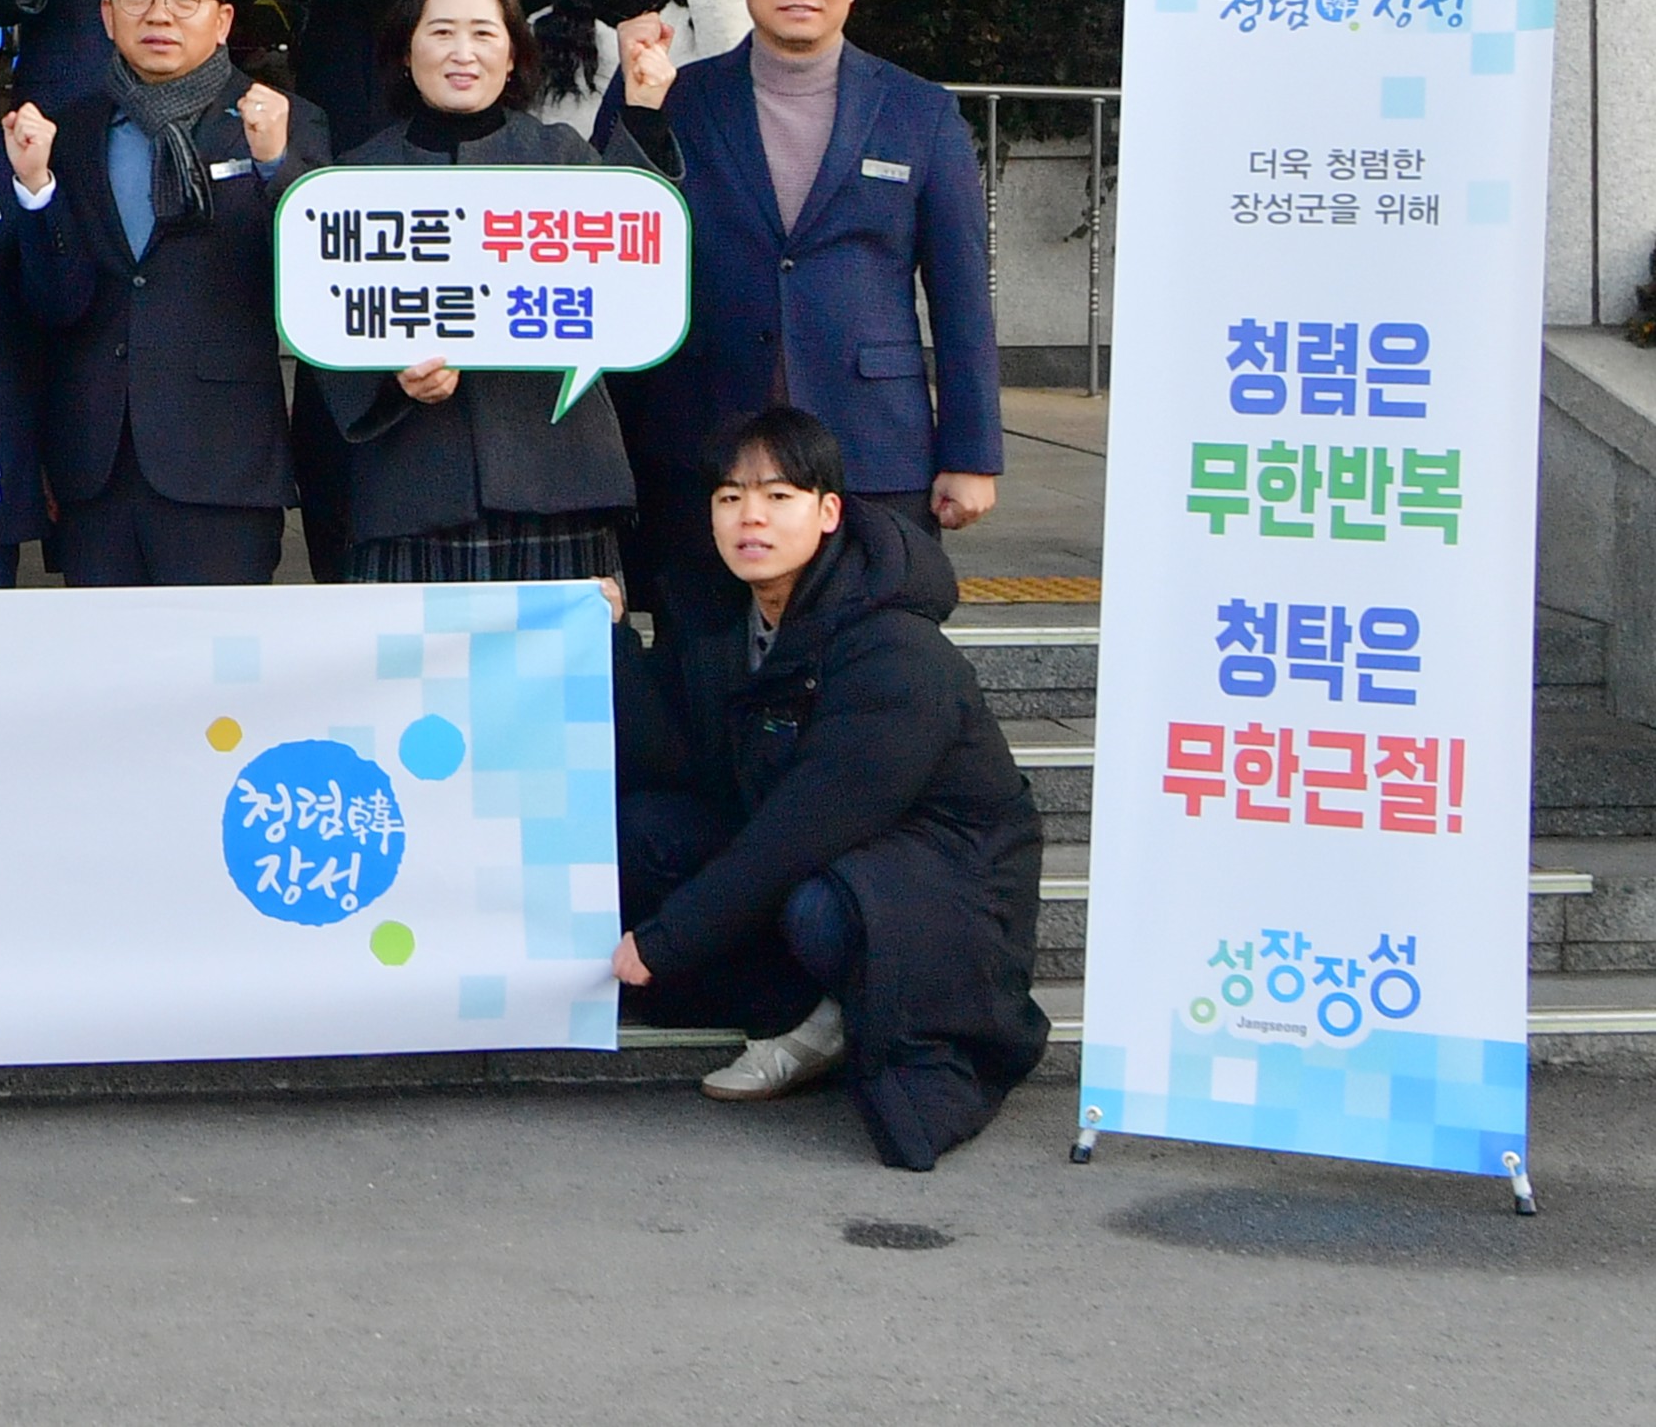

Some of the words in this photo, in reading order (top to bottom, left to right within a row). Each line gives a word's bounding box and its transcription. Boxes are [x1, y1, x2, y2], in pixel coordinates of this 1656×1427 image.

[1251, 149, 1311, 179] 더욱
[1328, 149, 1425, 180] 청렴한
[482, 210, 660, 264] 부정부패
[1231, 194, 1359, 224] 장성군을
[1376, 195, 1438, 225] 위해
[507, 286, 593, 339] 청렴
[1227, 318, 1430, 418] 청렴은
[1187, 440, 1462, 545] 무한반복
[1216, 599, 1420, 705] 청탁은
[1163, 722, 1464, 834] 무한근절!
[254, 845, 361, 911] 장성
[1206, 929, 1422, 1038] 성장장성
[1235, 1014, 1309, 1038] Jangseong
